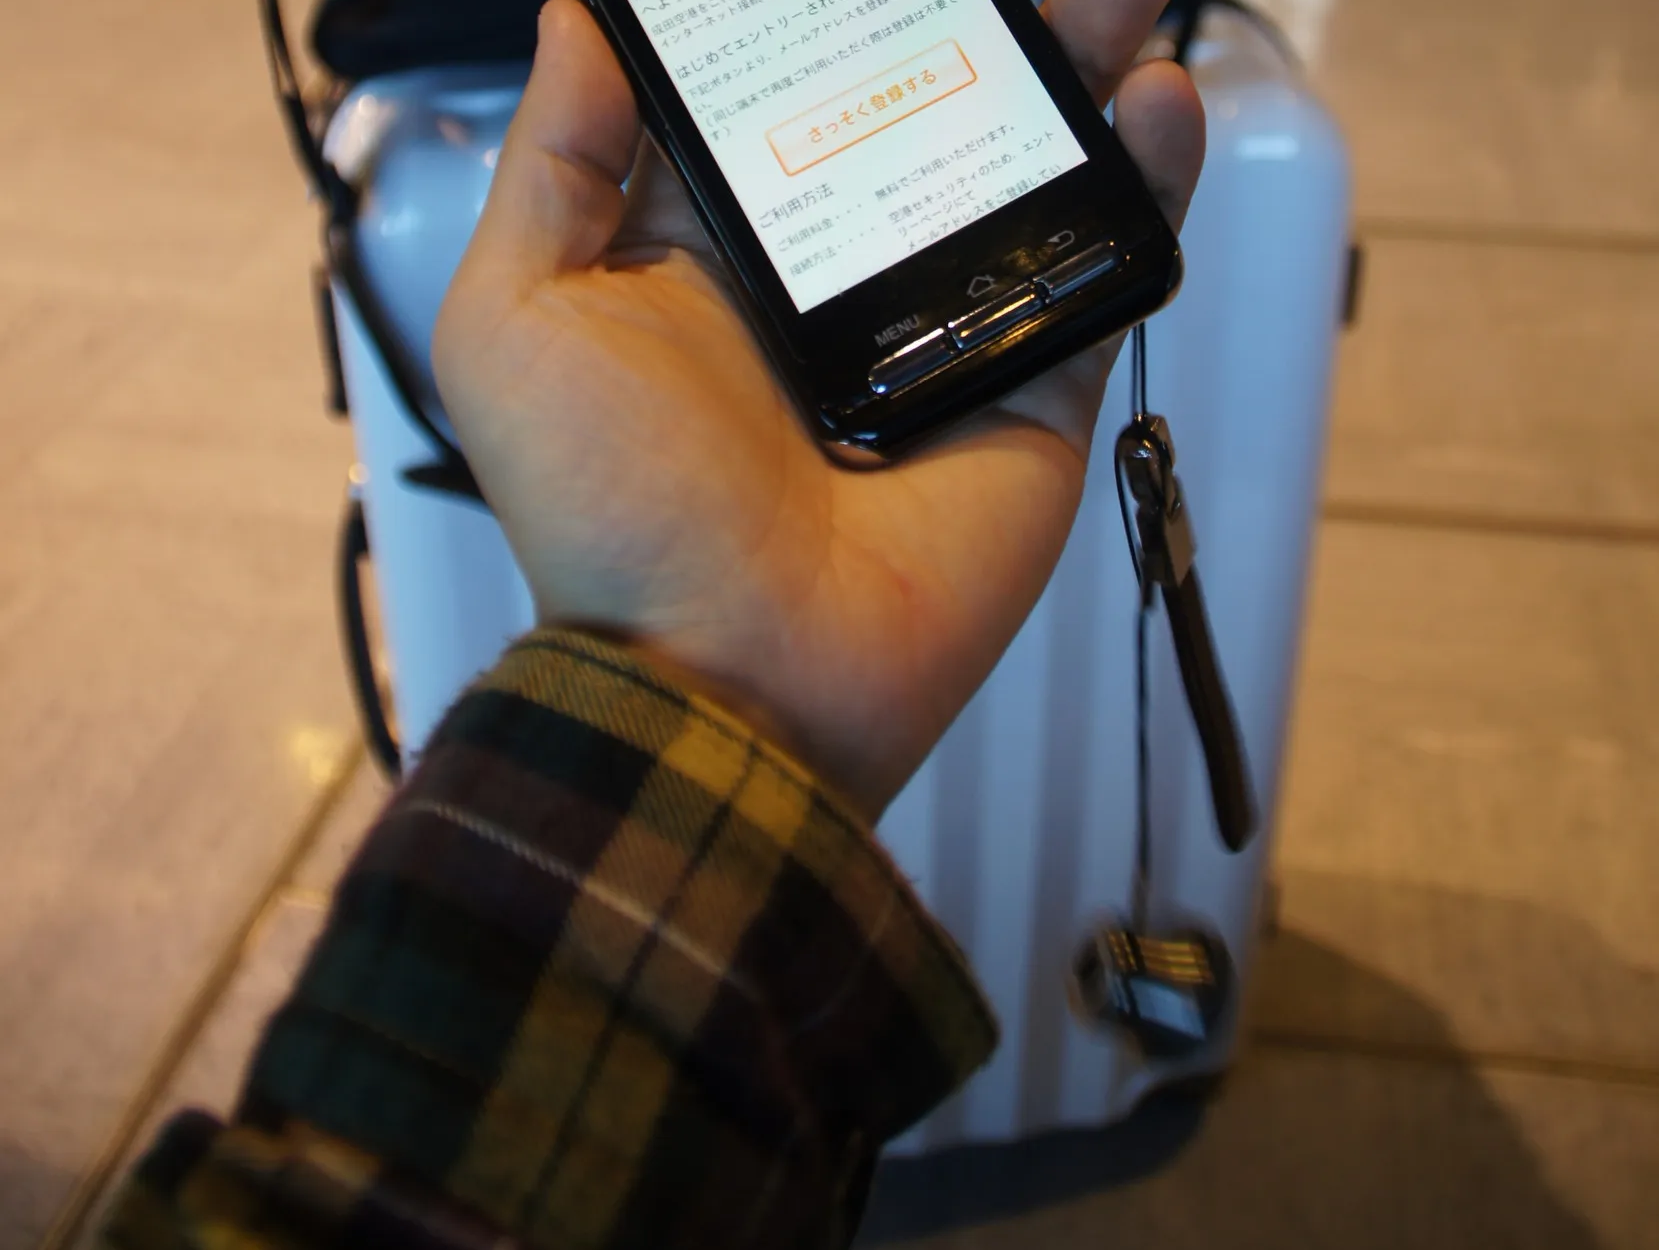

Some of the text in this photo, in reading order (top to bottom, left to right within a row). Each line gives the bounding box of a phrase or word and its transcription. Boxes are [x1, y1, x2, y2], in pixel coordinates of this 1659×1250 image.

[806, 66, 939, 145] さっそく登録する
[873, 119, 1016, 202] 無料でご利用いただけます。
[756, 180, 834, 231] ご利用方法
[896, 188, 978, 239] リーページにて
[873, 313, 921, 347] MENU
